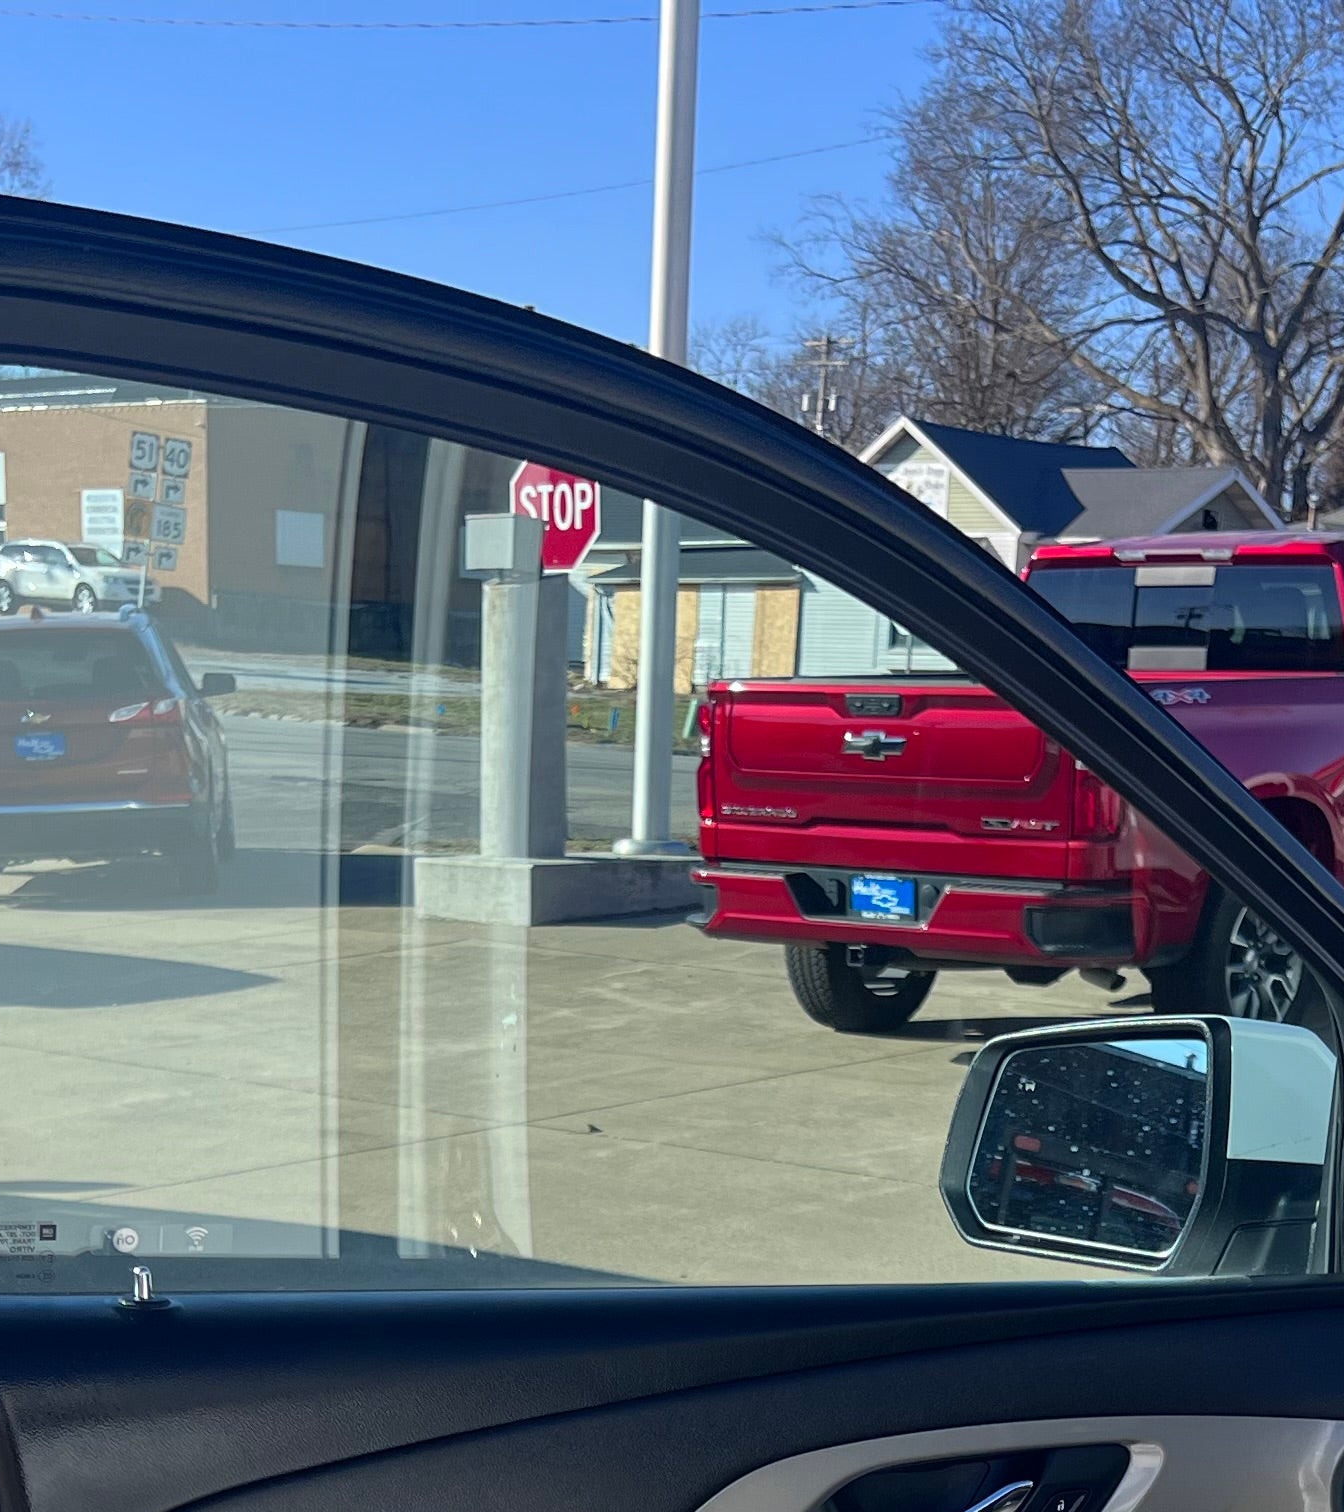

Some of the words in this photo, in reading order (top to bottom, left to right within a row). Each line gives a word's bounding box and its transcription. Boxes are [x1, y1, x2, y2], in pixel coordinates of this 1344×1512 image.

[135, 439, 154, 463] 51
[164, 447, 189, 470] 40
[519, 481, 594, 532] STOP
[156, 518, 182, 540] 185
